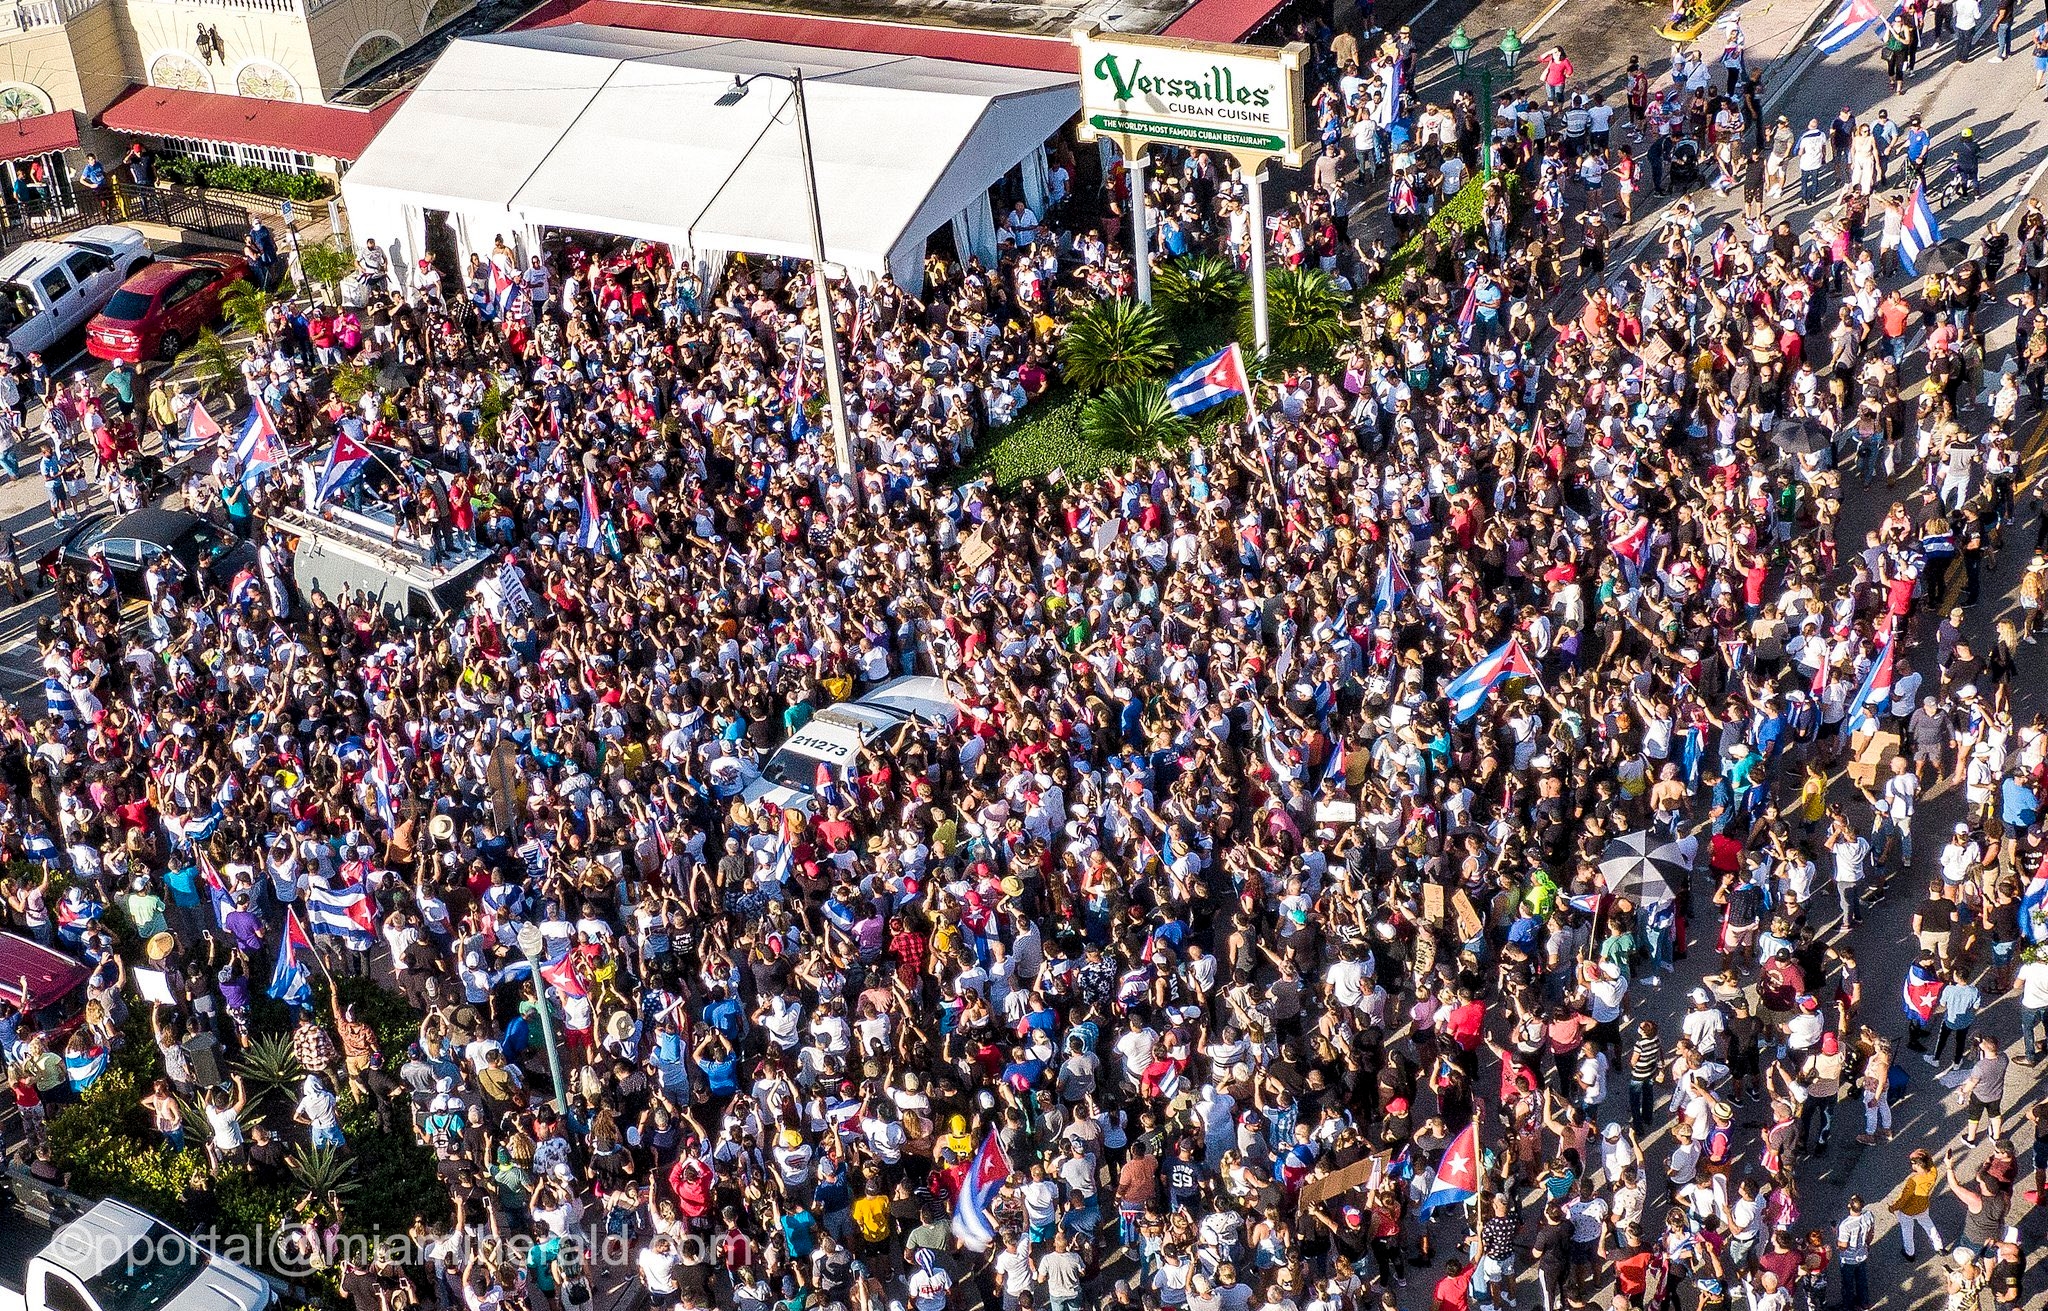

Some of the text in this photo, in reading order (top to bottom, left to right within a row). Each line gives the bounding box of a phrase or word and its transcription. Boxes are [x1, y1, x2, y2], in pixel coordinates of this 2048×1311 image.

[1094, 52, 1270, 108] Versailles
[1169, 102, 1270, 123] CUBAN CUISINE
[1103, 119, 1117, 128] THE
[1118, 121, 1148, 132] WORLD'S
[1149, 125, 1168, 135] MOST
[1169, 127, 1197, 138] FAMOUS
[1198, 131, 1222, 141] CUBAN
[791, 735, 848, 758] 211273
[1172, 1172, 1193, 1188] 99
